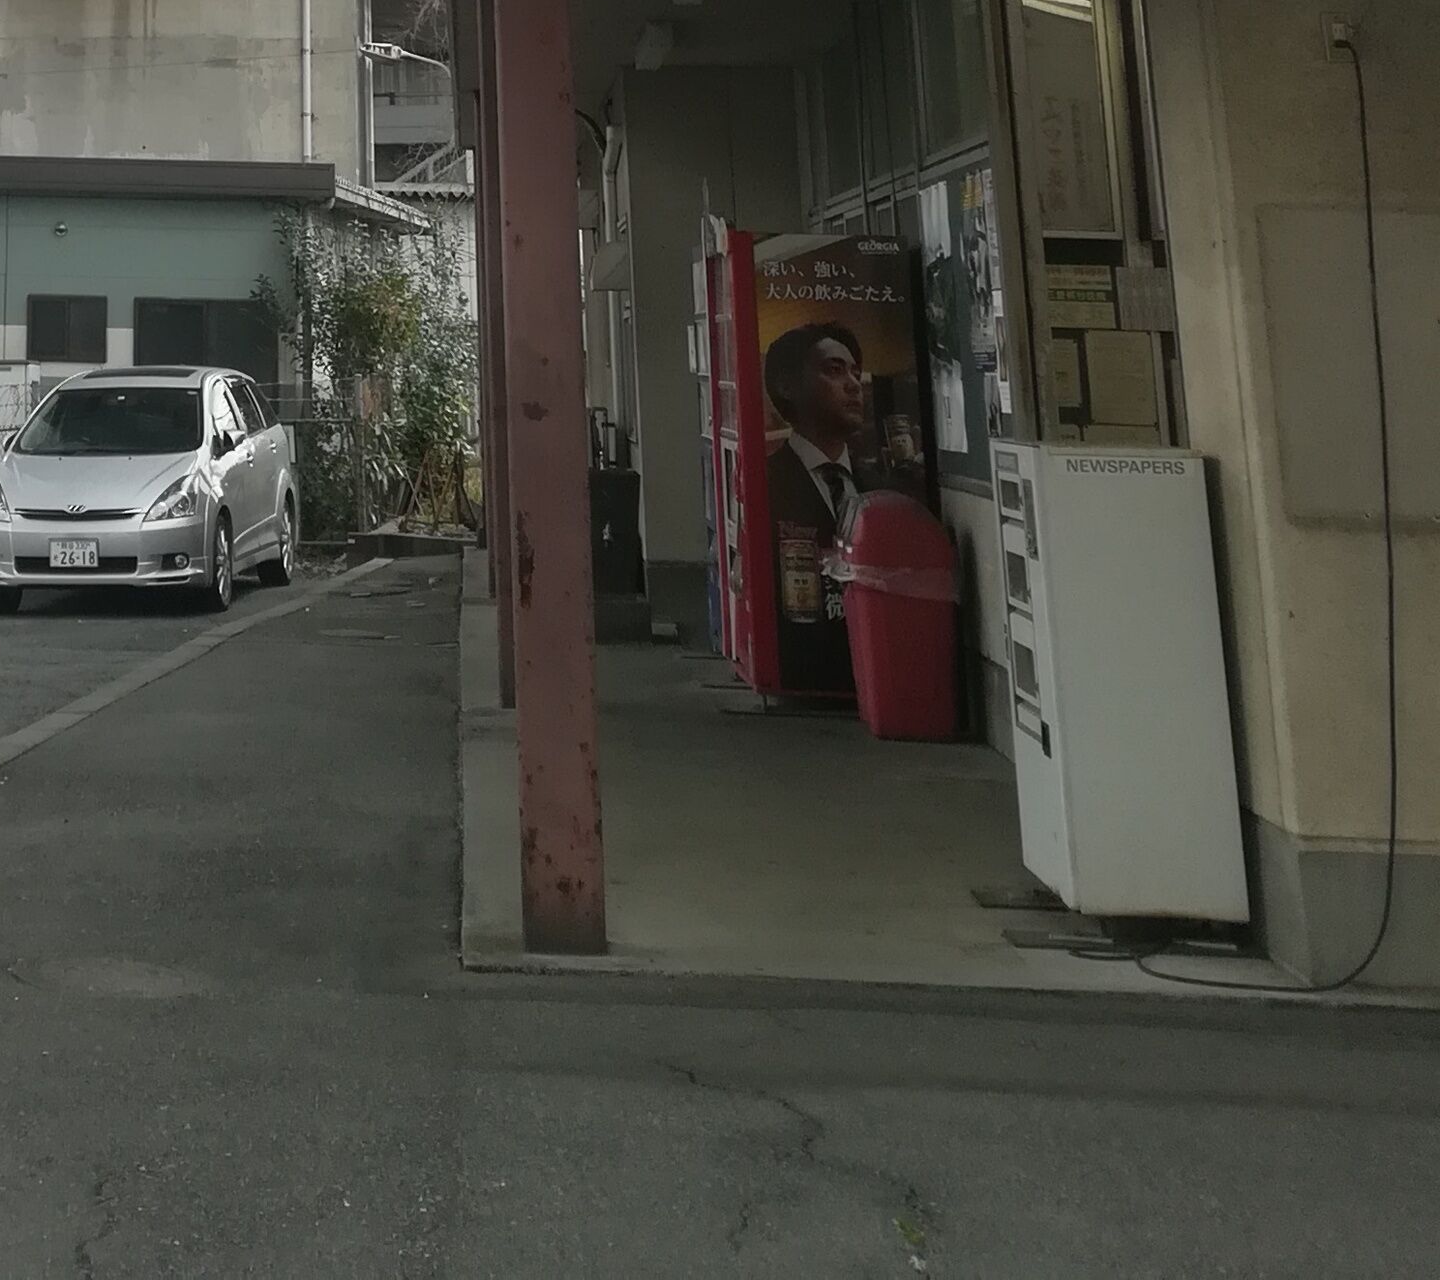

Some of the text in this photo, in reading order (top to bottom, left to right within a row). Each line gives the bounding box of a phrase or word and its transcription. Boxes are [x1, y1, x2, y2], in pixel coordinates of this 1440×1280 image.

[857, 239, 900, 252] GEORGIA
[766, 282, 905, 302] 大人の飲みごたえ。
[1066, 458, 1186, 476] NEWSPAPERS
[60, 551, 96, 565] 26-18
